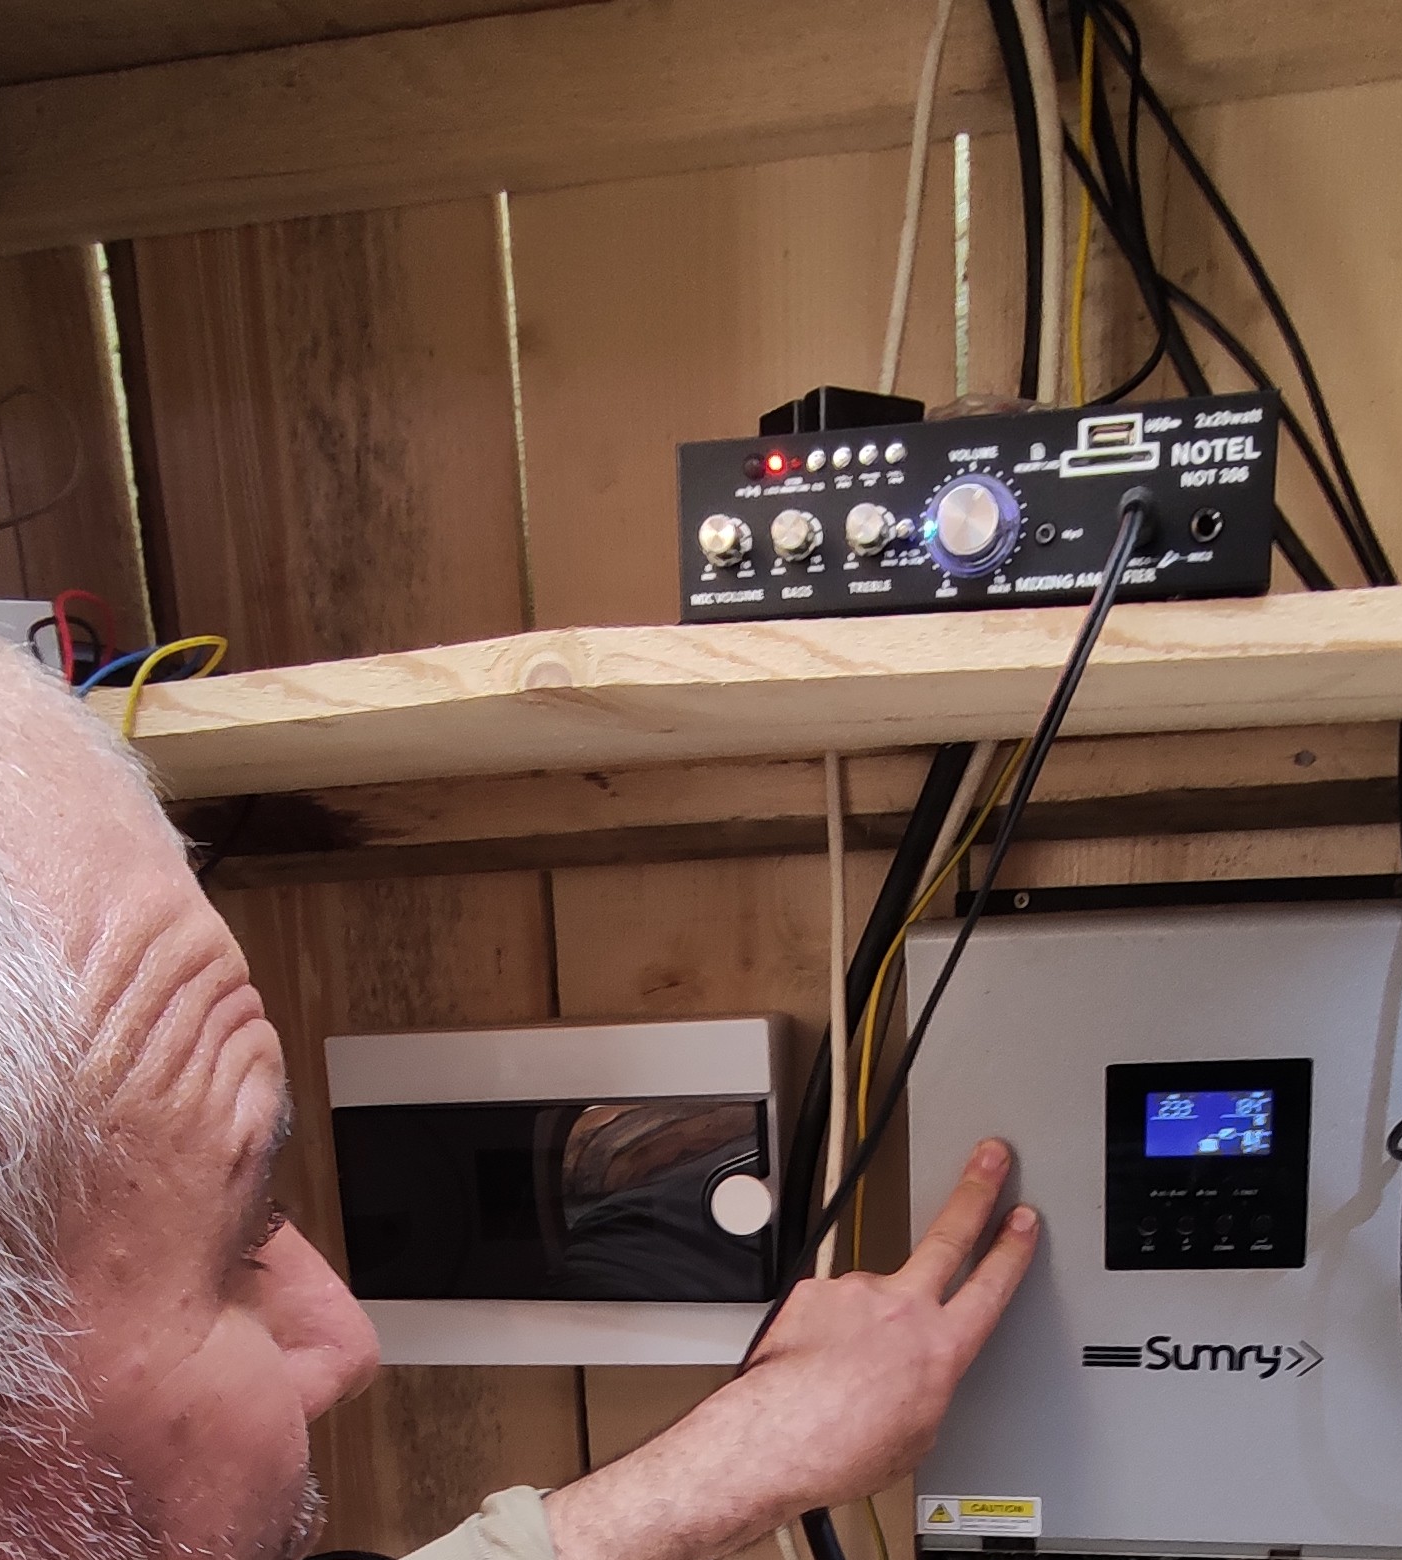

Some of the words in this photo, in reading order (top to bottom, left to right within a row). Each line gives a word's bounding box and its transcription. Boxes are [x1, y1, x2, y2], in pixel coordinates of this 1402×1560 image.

[1170, 435, 1262, 467] NOTEL
[1180, 468, 1218, 488] NOT
[1145, 1335, 1281, 1380] Sumry
[970, 1503, 1025, 1513] CAUTION
